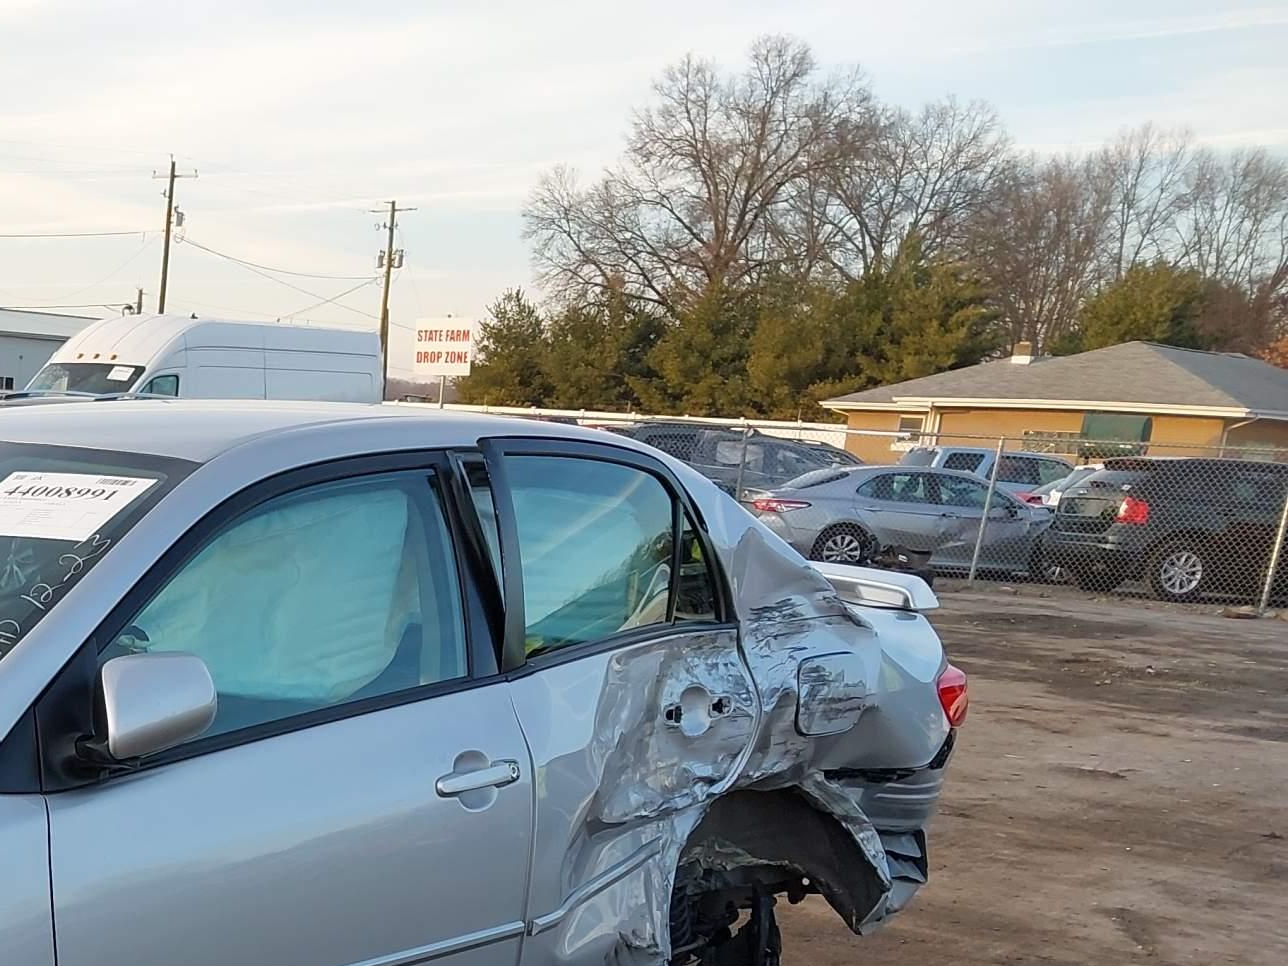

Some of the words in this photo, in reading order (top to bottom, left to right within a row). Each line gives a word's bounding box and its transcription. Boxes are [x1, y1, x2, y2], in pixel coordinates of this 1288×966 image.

[417, 329, 444, 342] STATE
[445, 329, 470, 342] FARM
[416, 351, 443, 364] DROP
[444, 351, 468, 364] ZONE
[4, 485, 119, 501] 44008991
